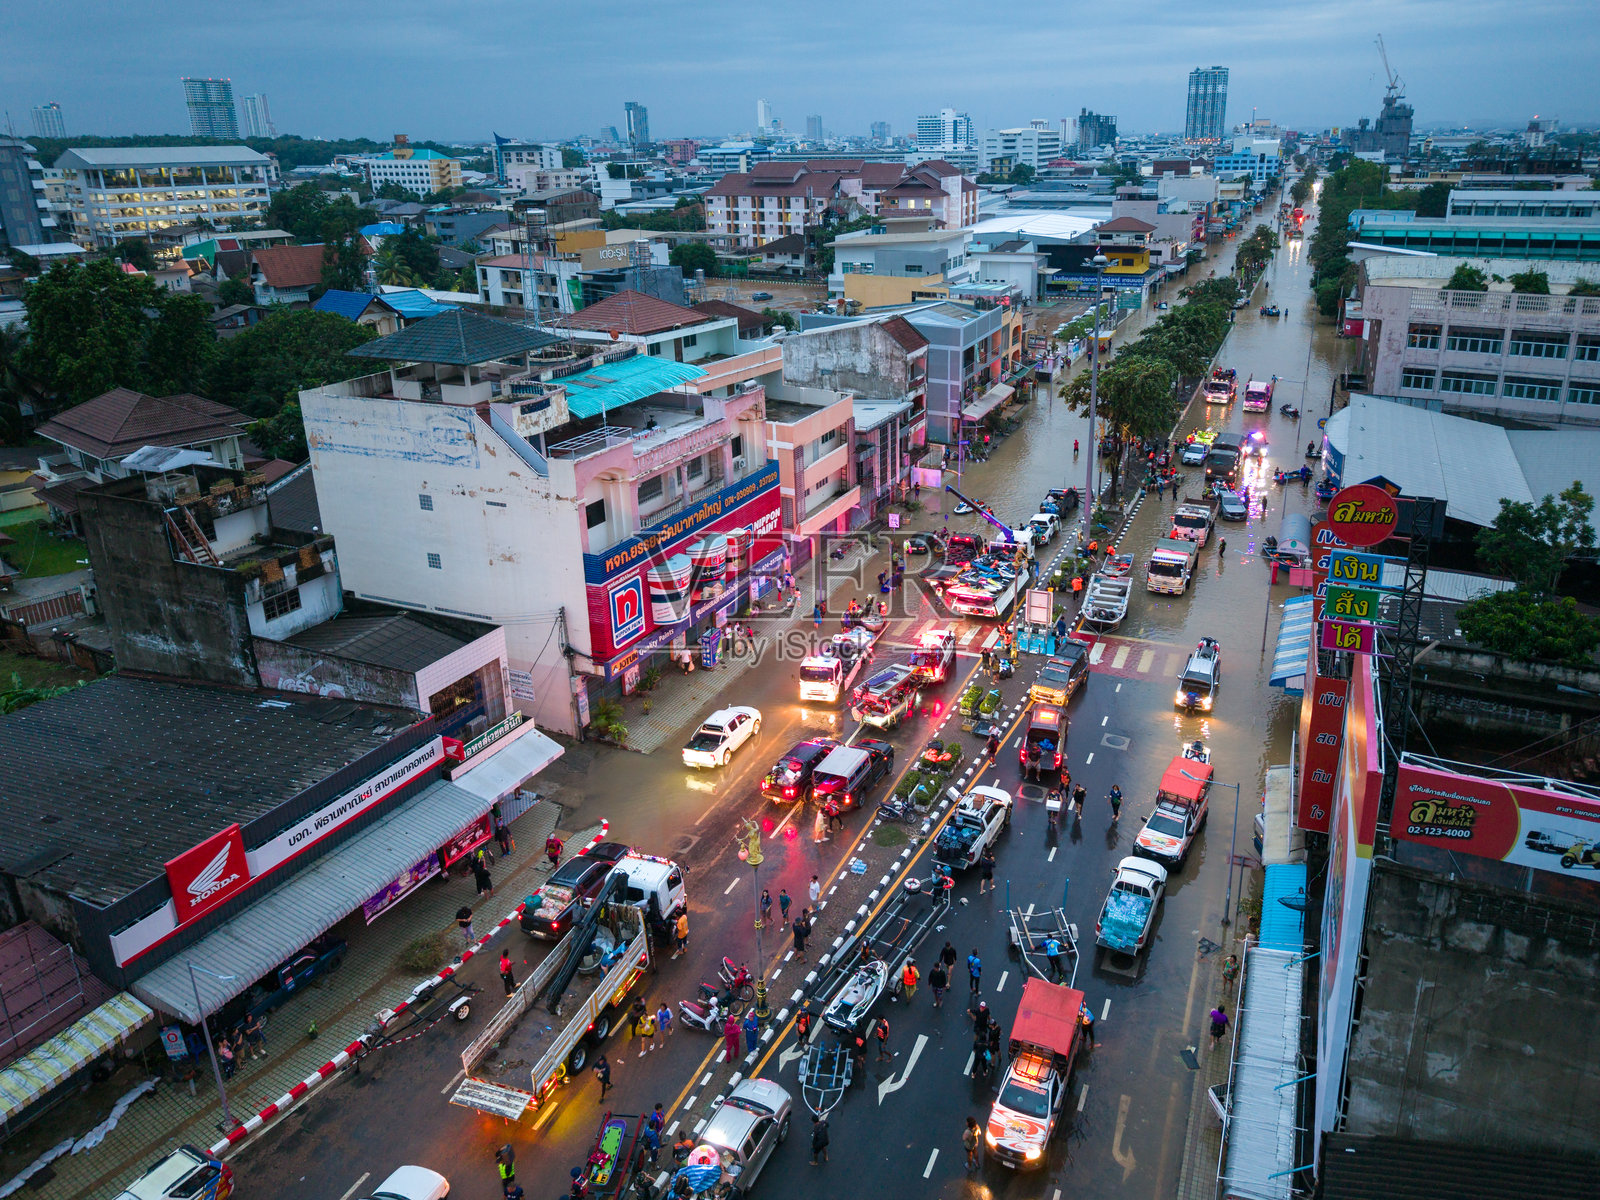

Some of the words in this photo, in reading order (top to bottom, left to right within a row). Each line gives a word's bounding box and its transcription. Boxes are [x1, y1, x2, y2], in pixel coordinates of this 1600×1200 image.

[754, 507, 781, 531] NIPPON
[1333, 501, 1395, 524] สมหวัง
[757, 518, 779, 539] PAINT
[1333, 556, 1378, 582] เงิน
[1335, 590, 1369, 617] สั่ง
[639, 640, 658, 656] Quality
[659, 628, 675, 642] Paints
[1331, 624, 1362, 650] ได้
[618, 650, 639, 671] JOTUN
[1319, 692, 1345, 707] เงิน
[1315, 732, 1338, 746] สด
[1311, 768, 1332, 784] ทัน
[288, 828, 313, 847] บจก.
[374, 746, 435, 793] สาขาแยกคอหงส์
[1310, 804, 1325, 820] ใจ
[1410, 799, 1474, 823] สมหวัง
[1407, 826, 1471, 838] 02-123-4000
[190, 873, 240, 907] HONDA
